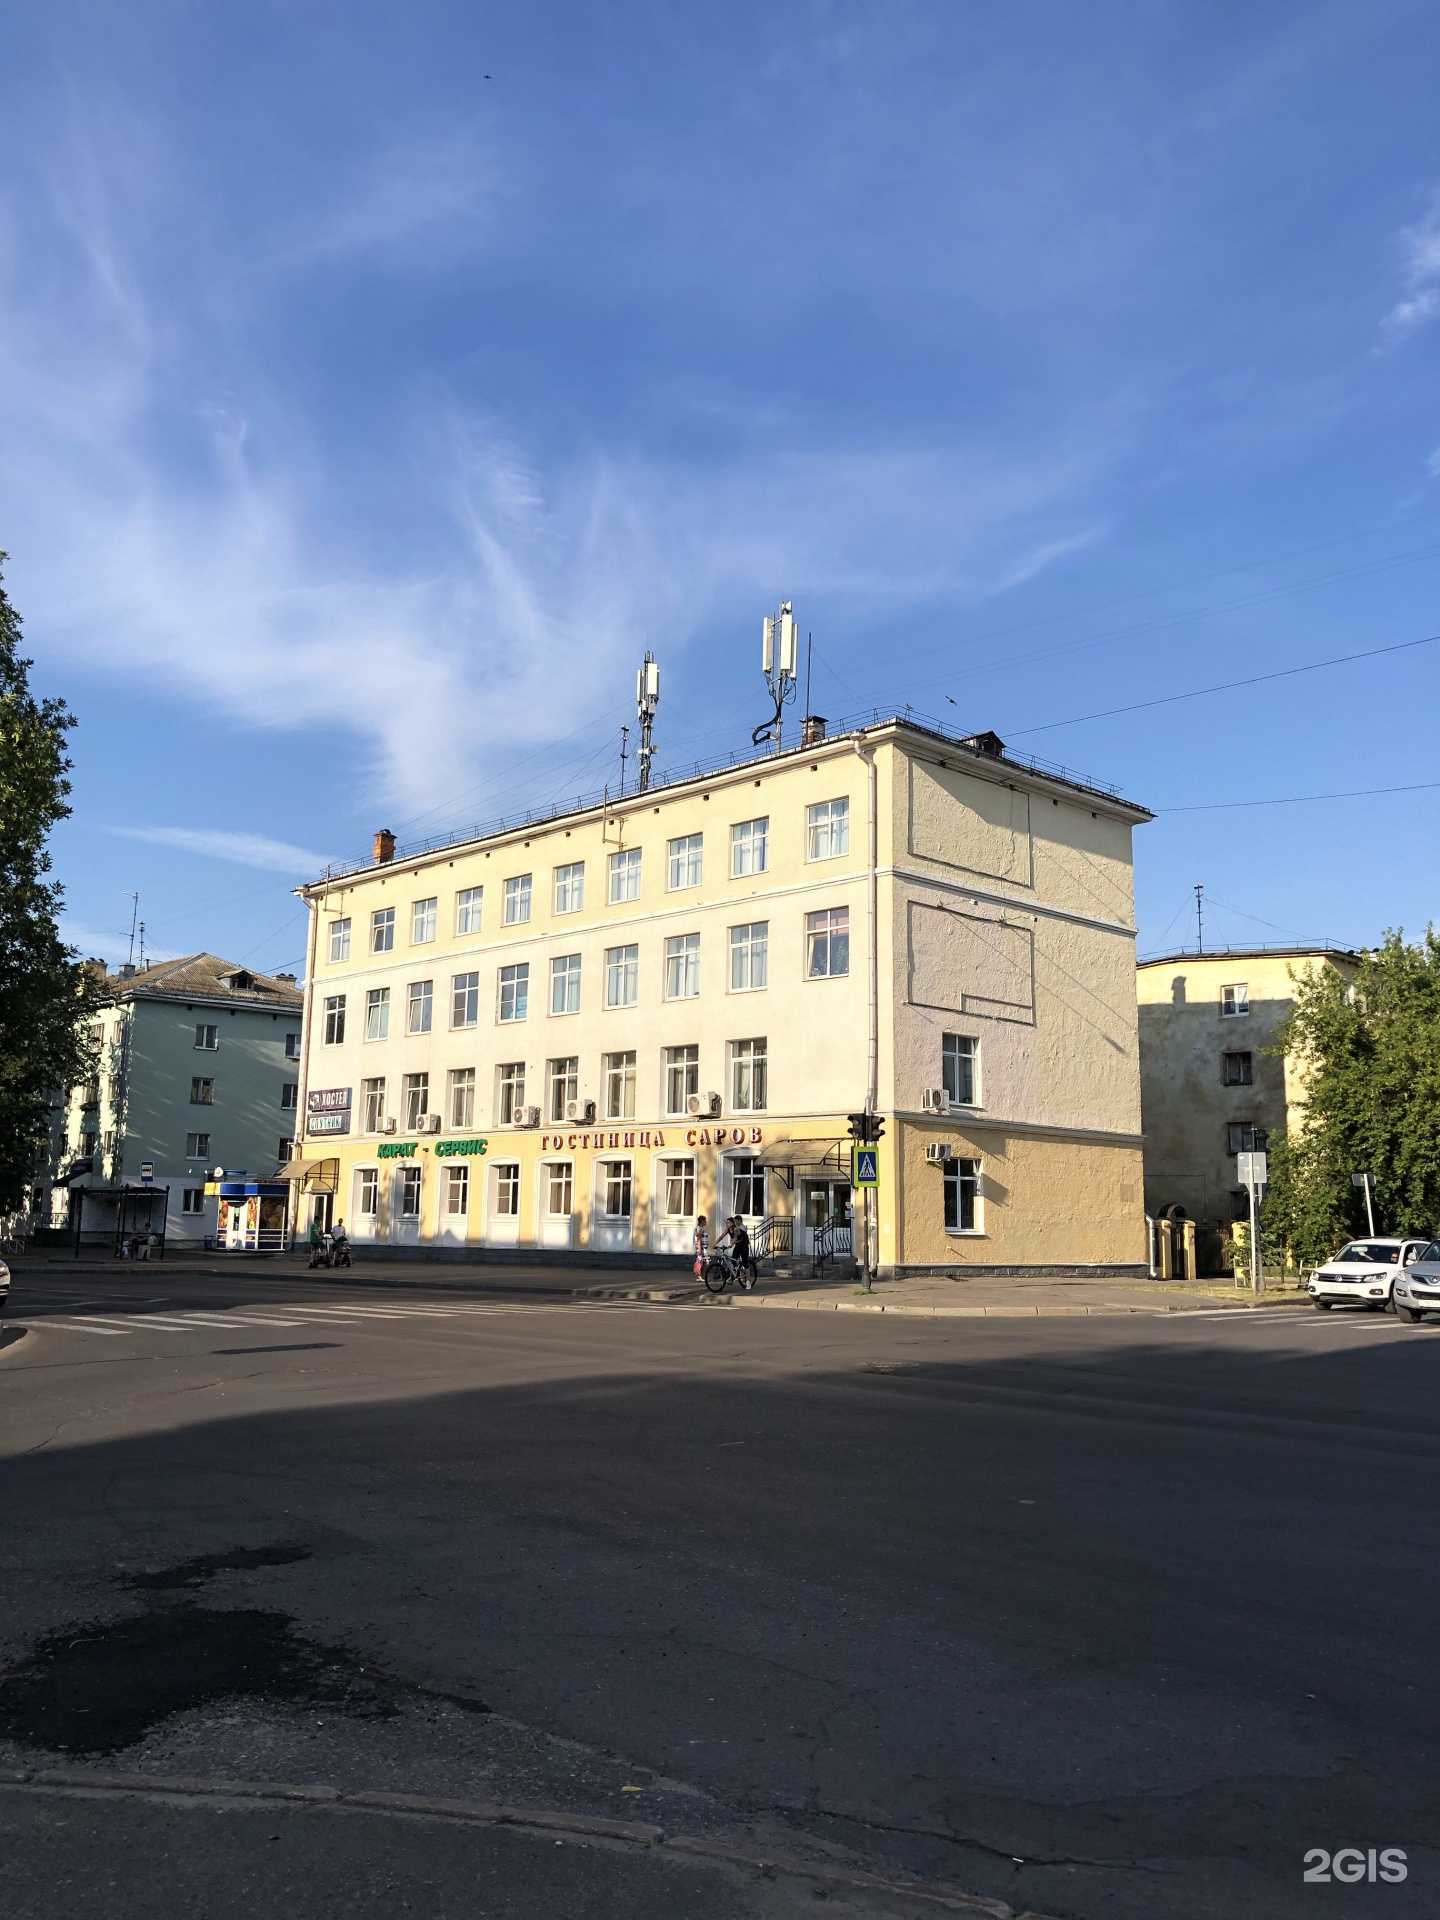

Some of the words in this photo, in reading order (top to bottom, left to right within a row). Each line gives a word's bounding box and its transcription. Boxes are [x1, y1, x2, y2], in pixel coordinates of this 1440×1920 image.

[321, 1092, 347, 1106] ХОСТЕЛ
[310, 1117, 341, 1129] СПУТНИК
[540, 1130, 666, 1151] ГОСТИНИЦА
[685, 1127, 763, 1146] САРОВ
[377, 1142, 418, 1158] КАРАТ
[434, 1139, 488, 1157] СЕРВИС
